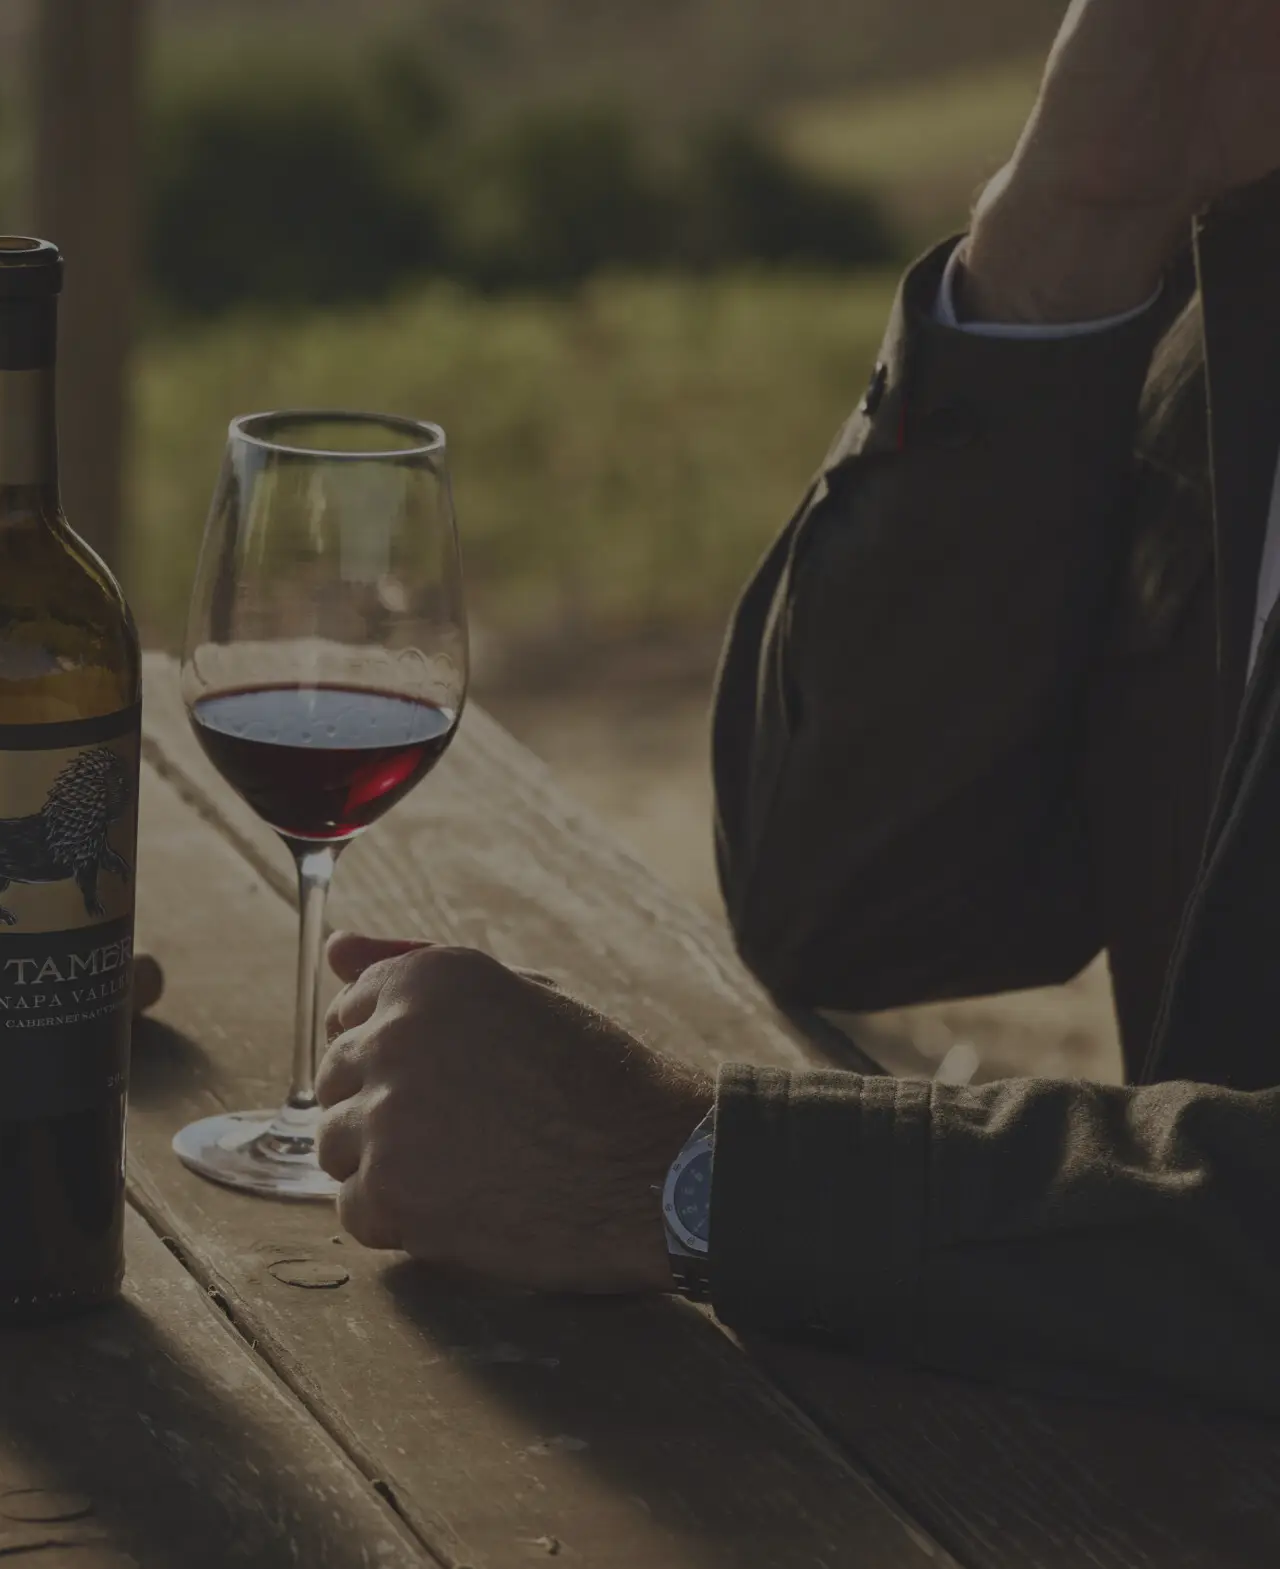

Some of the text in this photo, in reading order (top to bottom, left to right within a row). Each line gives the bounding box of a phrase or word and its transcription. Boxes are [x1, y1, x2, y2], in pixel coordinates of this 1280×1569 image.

[3, 935, 133, 986] TAMER
[71, 970, 128, 1004] VALLE
[4, 1010, 81, 1029] CABERNET
